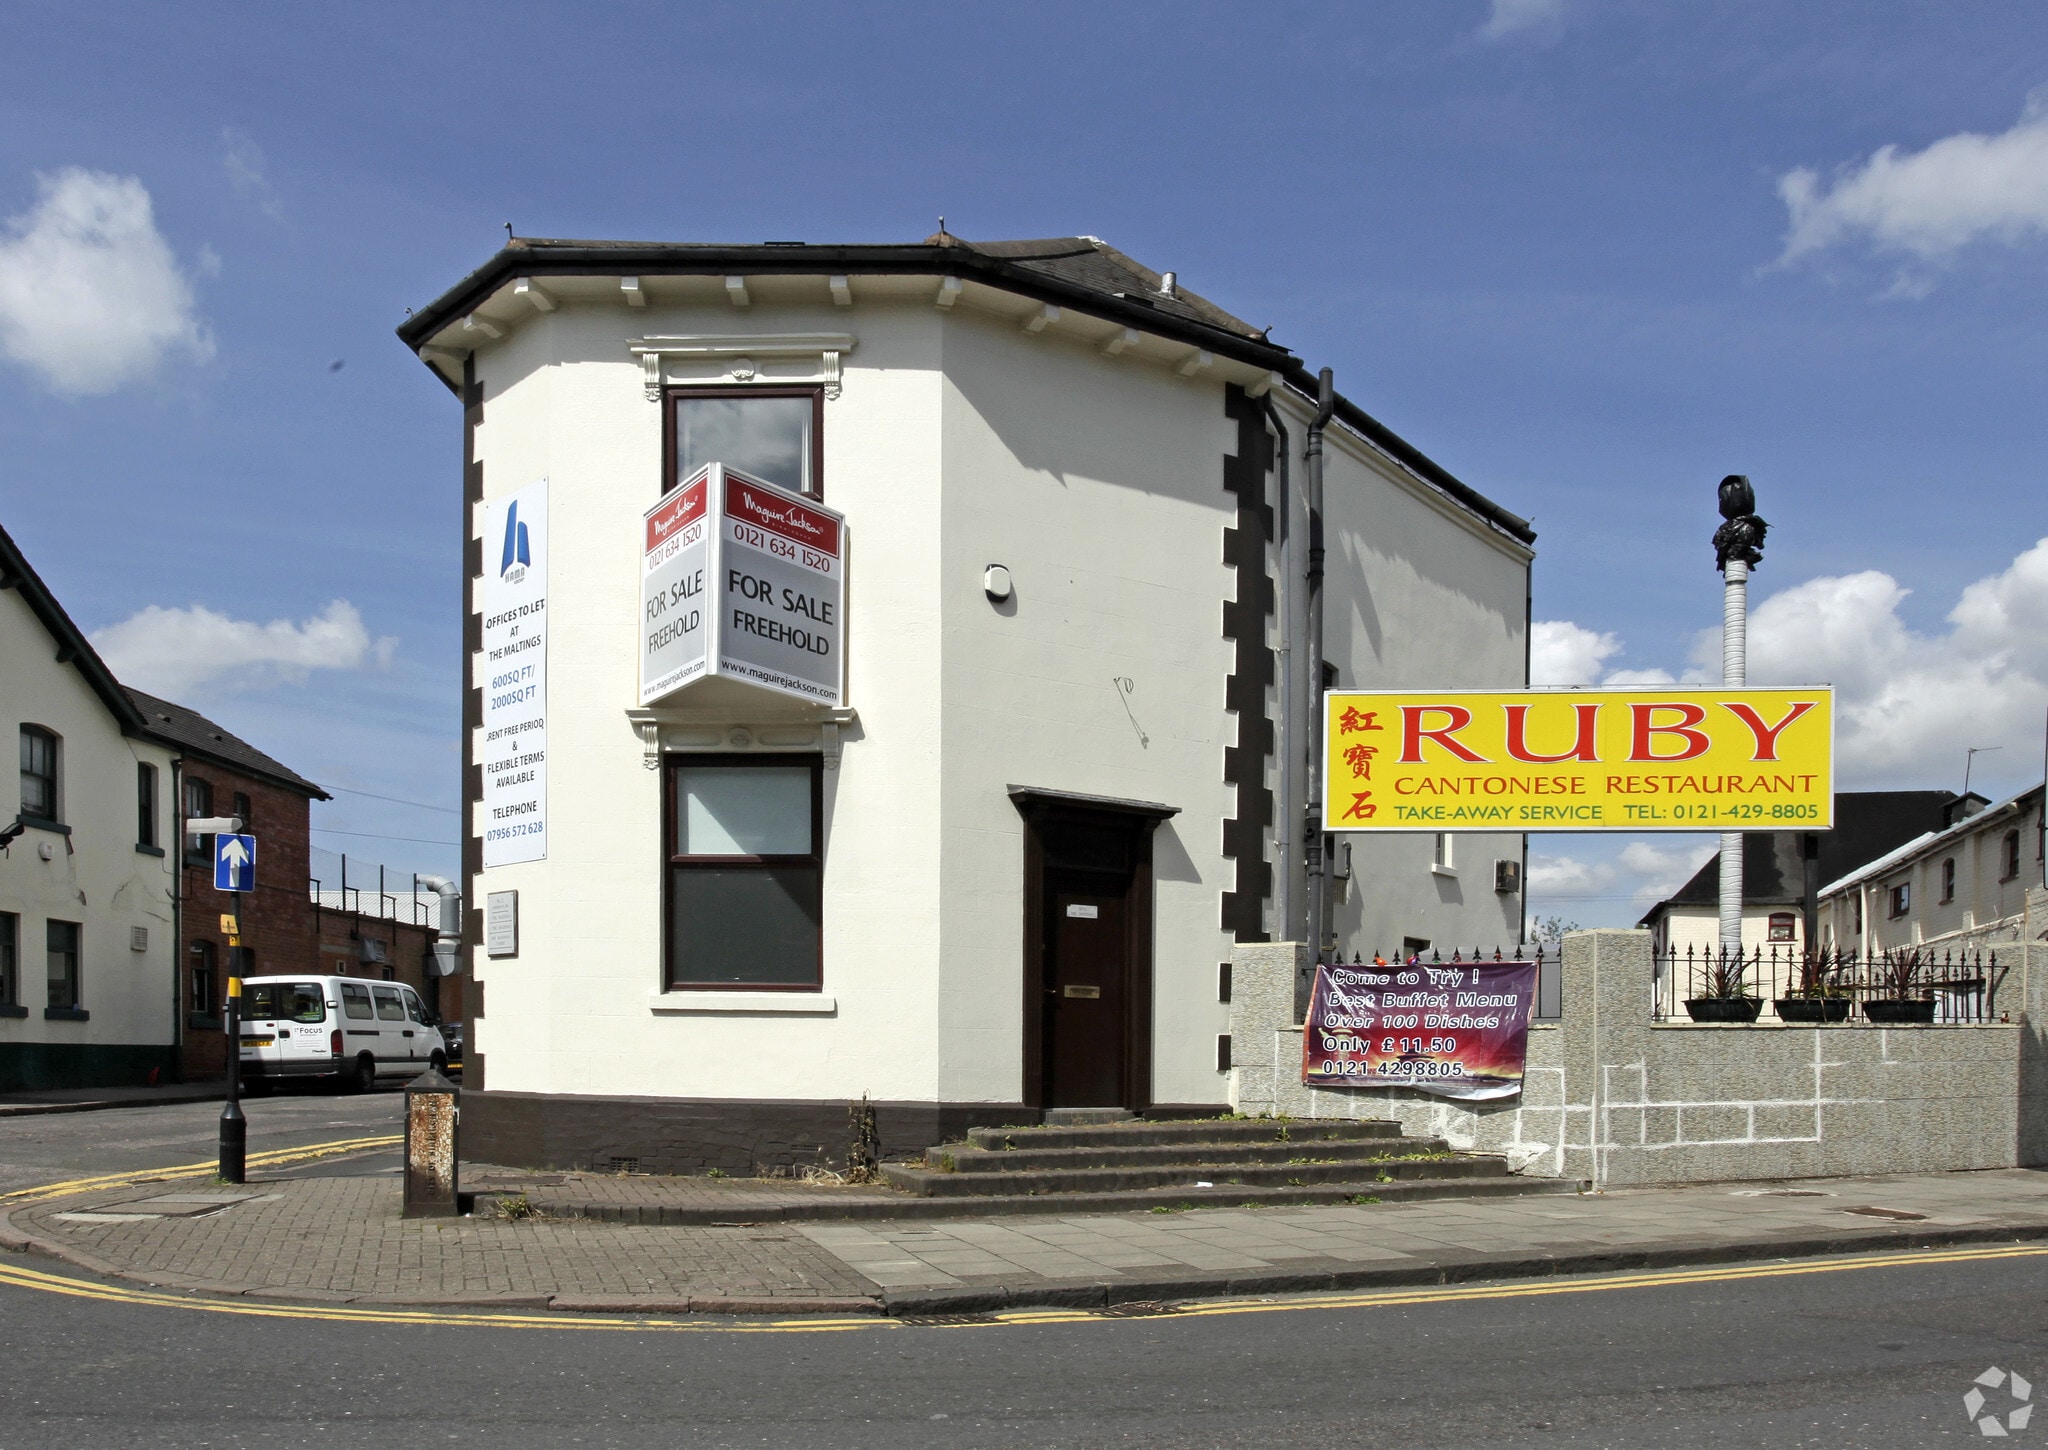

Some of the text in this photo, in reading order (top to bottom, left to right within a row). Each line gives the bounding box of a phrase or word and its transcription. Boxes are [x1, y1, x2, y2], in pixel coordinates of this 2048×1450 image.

[742, 491, 785, 524] Maguire
[649, 548, 664, 570] 0121
[666, 537, 680, 558] 634
[682, 523, 702, 548] 1520
[734, 524, 765, 548] 0121
[770, 538, 796, 560] 634
[802, 549, 830, 572] 1520
[646, 569, 703, 623] FOR SALE
[728, 569, 834, 626] FOR SALE
[486, 598, 545, 629] OFFICES TO LET
[510, 625, 520, 638] AT
[648, 609, 700, 655] FREEHOLD
[733, 609, 830, 656] FREEHOLD
[489, 634, 542, 662] THE MALTINGS
[492, 664, 536, 690] 600SQ FT/
[721, 660, 837, 701] www.maguirejackson.com
[492, 684, 536, 710] 2000SQ FT
[487, 718, 544, 741] RENT FREE PERIOD
[1394, 701, 1821, 764] RUBY
[512, 740, 518, 751] &
[488, 751, 545, 774] FLEXIBLE TERMS
[1338, 705, 1384, 821] 紅寶石
[496, 770, 535, 788] AVAILABLE
[1394, 774, 1819, 796] CANTONESE RESTAURANT
[492, 800, 538, 820] TELEPHONE
[1394, 804, 1818, 820] TAKE-AWAY SERVICE TEL: 0121-429-8805
[487, 821, 543, 842] 07956 572 628
[1332, 970, 1389, 985] Come
[1397, 970, 1420, 984] to
[1428, 968, 1464, 988] Try
[1328, 992, 1518, 1008] Best Buffet Menu
[1324, 1014, 1499, 1029] Over 100 Dishes
[1322, 1037, 1370, 1055] Only
[1322, 1060, 1464, 1077] 0121 4298805
